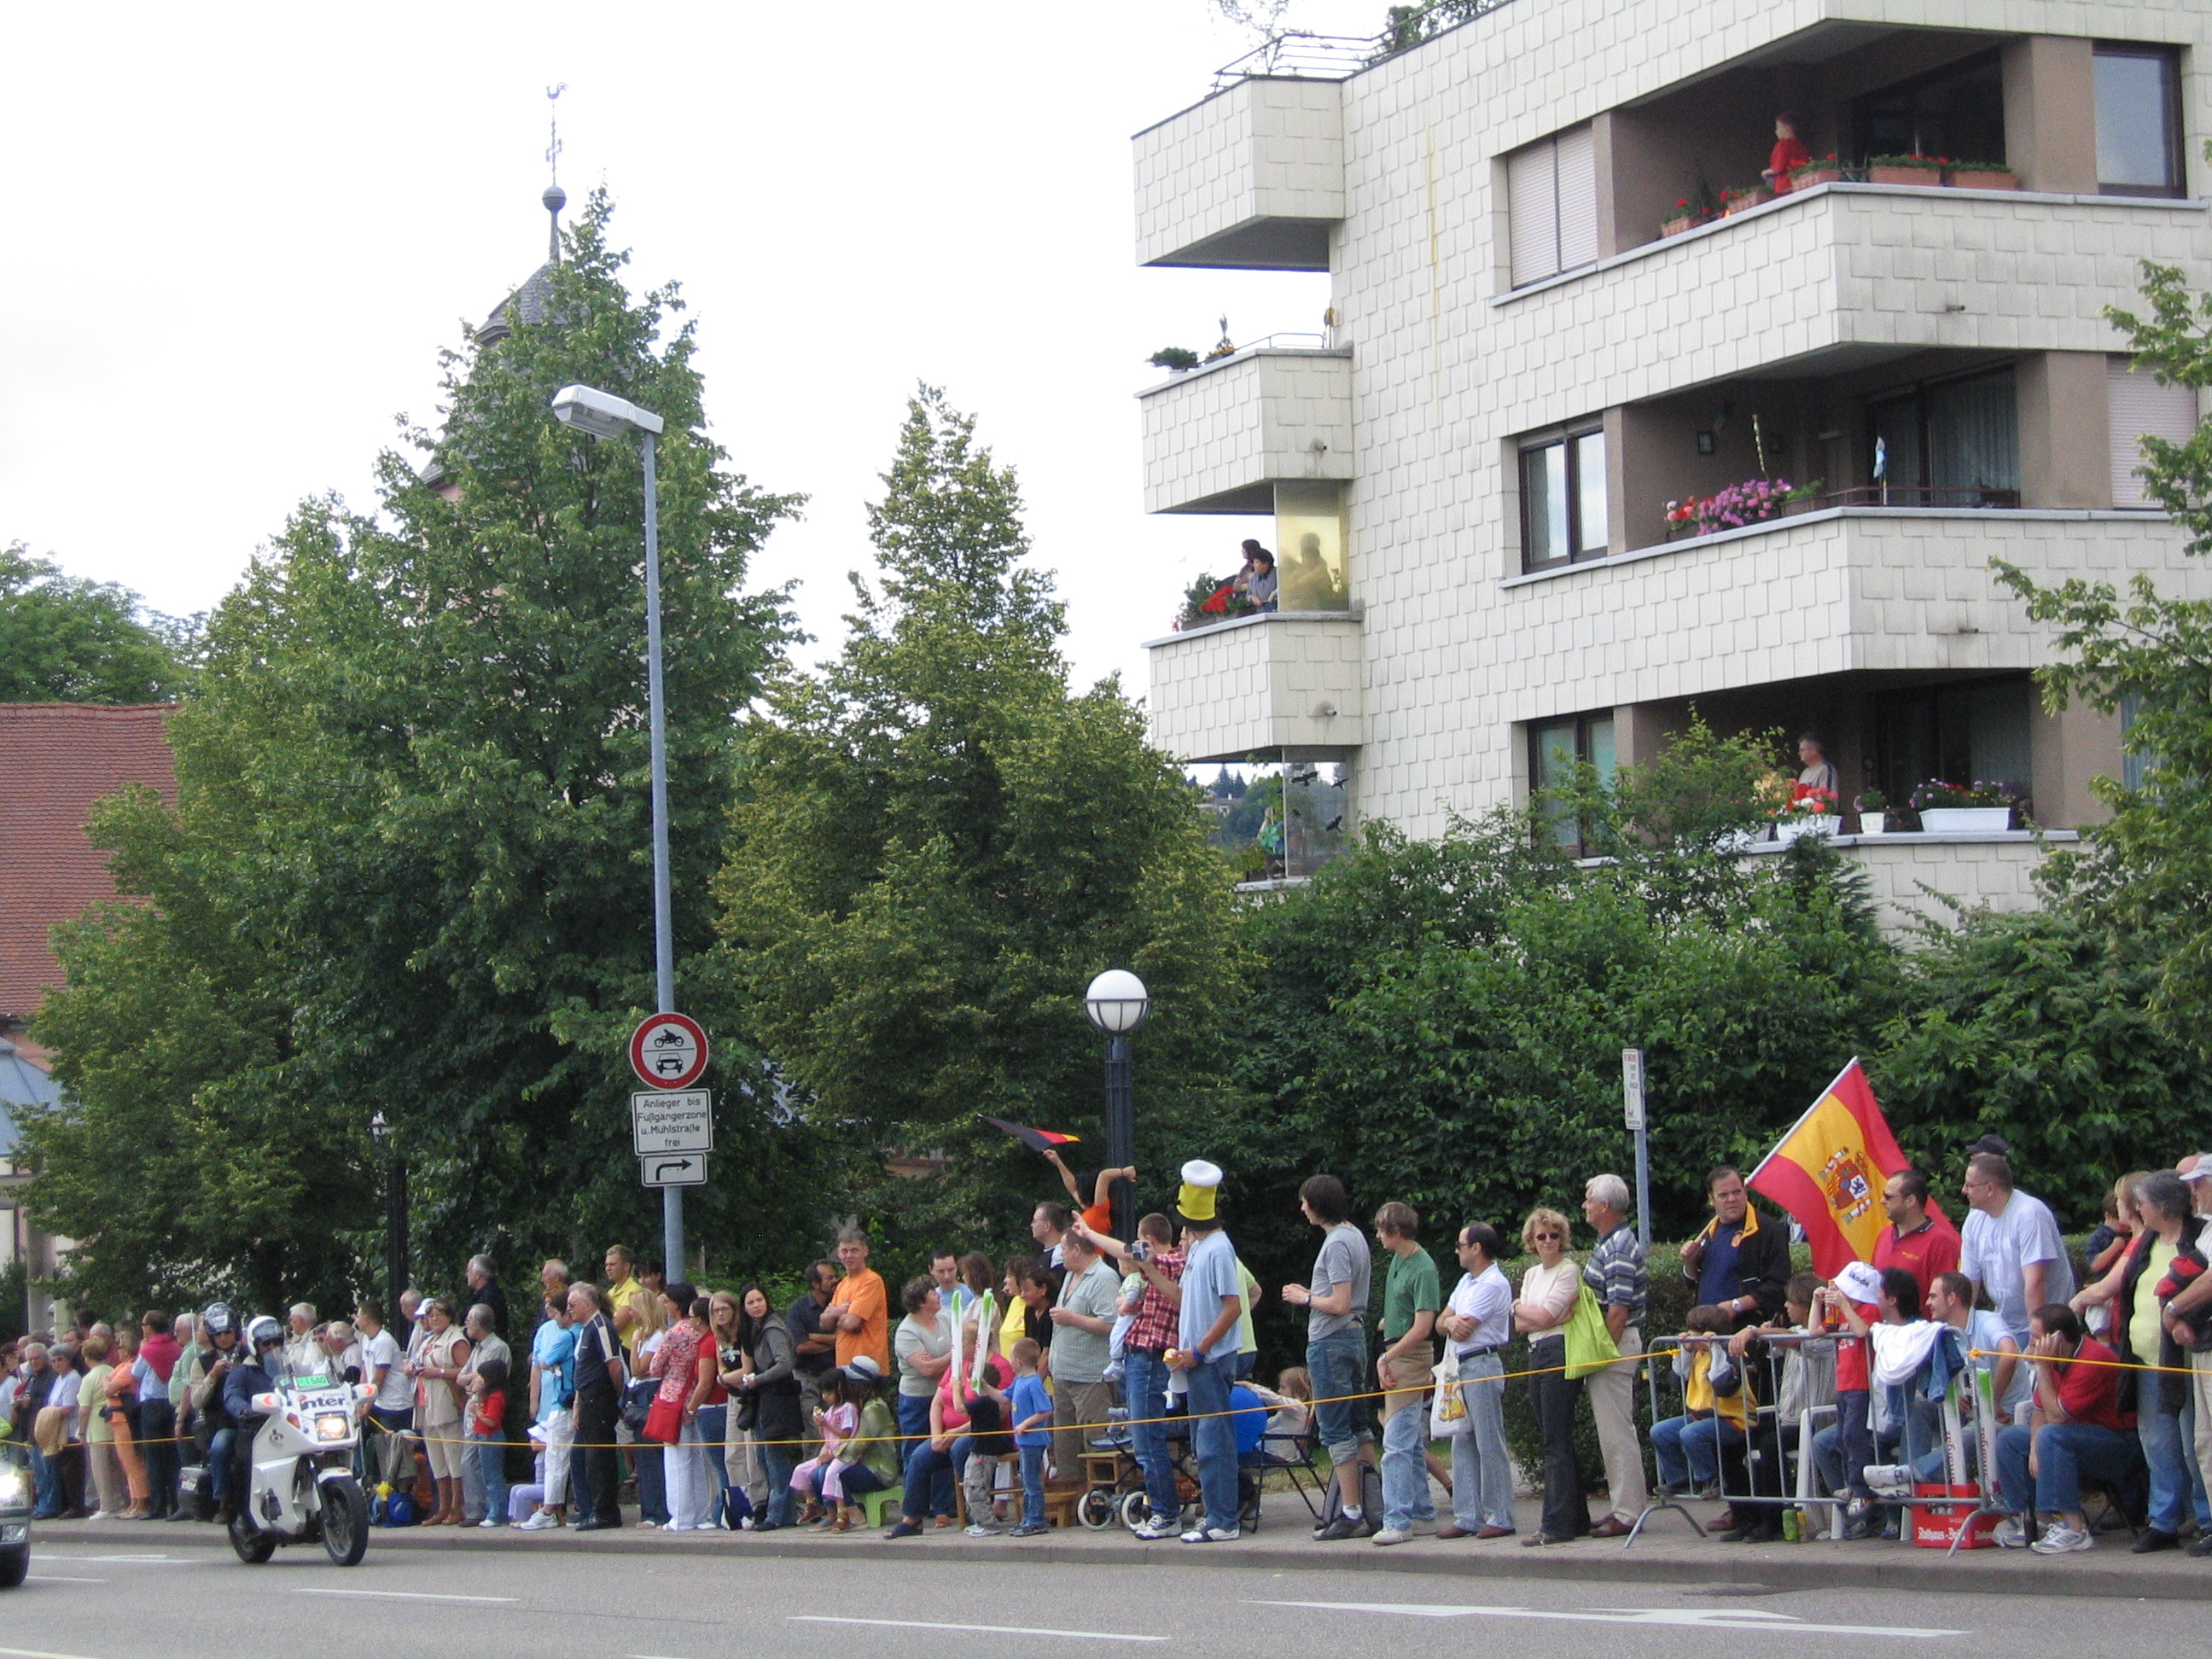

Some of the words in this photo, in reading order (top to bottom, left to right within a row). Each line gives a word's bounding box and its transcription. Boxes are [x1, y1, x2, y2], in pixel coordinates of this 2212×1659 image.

[643, 1099, 680, 1109] Anlieger
[687, 1097, 701, 1106] bis
[665, 1138, 680, 1147] frei
